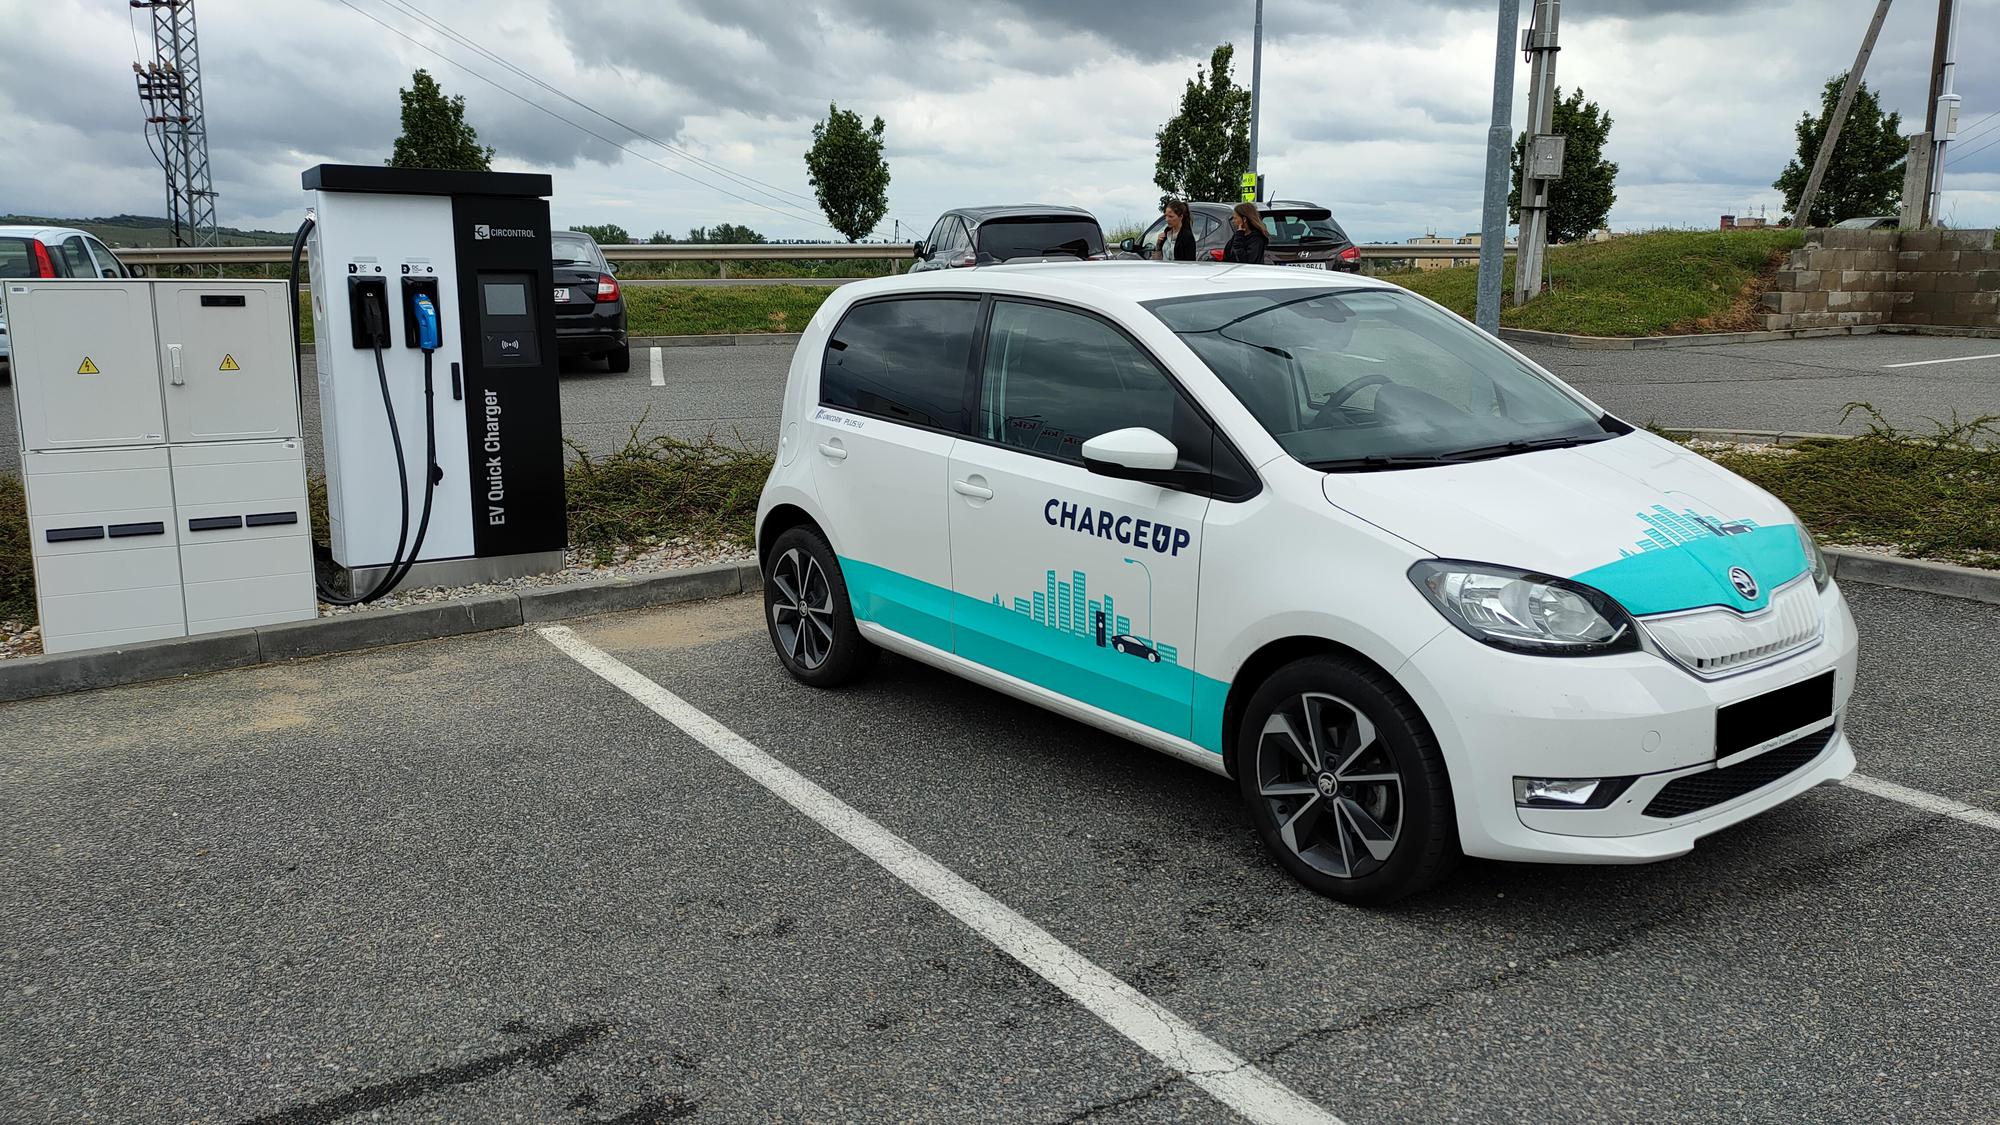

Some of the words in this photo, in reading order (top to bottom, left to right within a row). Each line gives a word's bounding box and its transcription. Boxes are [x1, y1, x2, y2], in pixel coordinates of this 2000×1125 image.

[491, 229, 536, 238] CIRCONTROL
[554, 289, 565, 298] 27
[484, 389, 501, 453] Charger
[486, 456, 504, 500] Quick
[490, 506, 505, 525] EV
[1044, 498, 1191, 557] CHARGEUP
